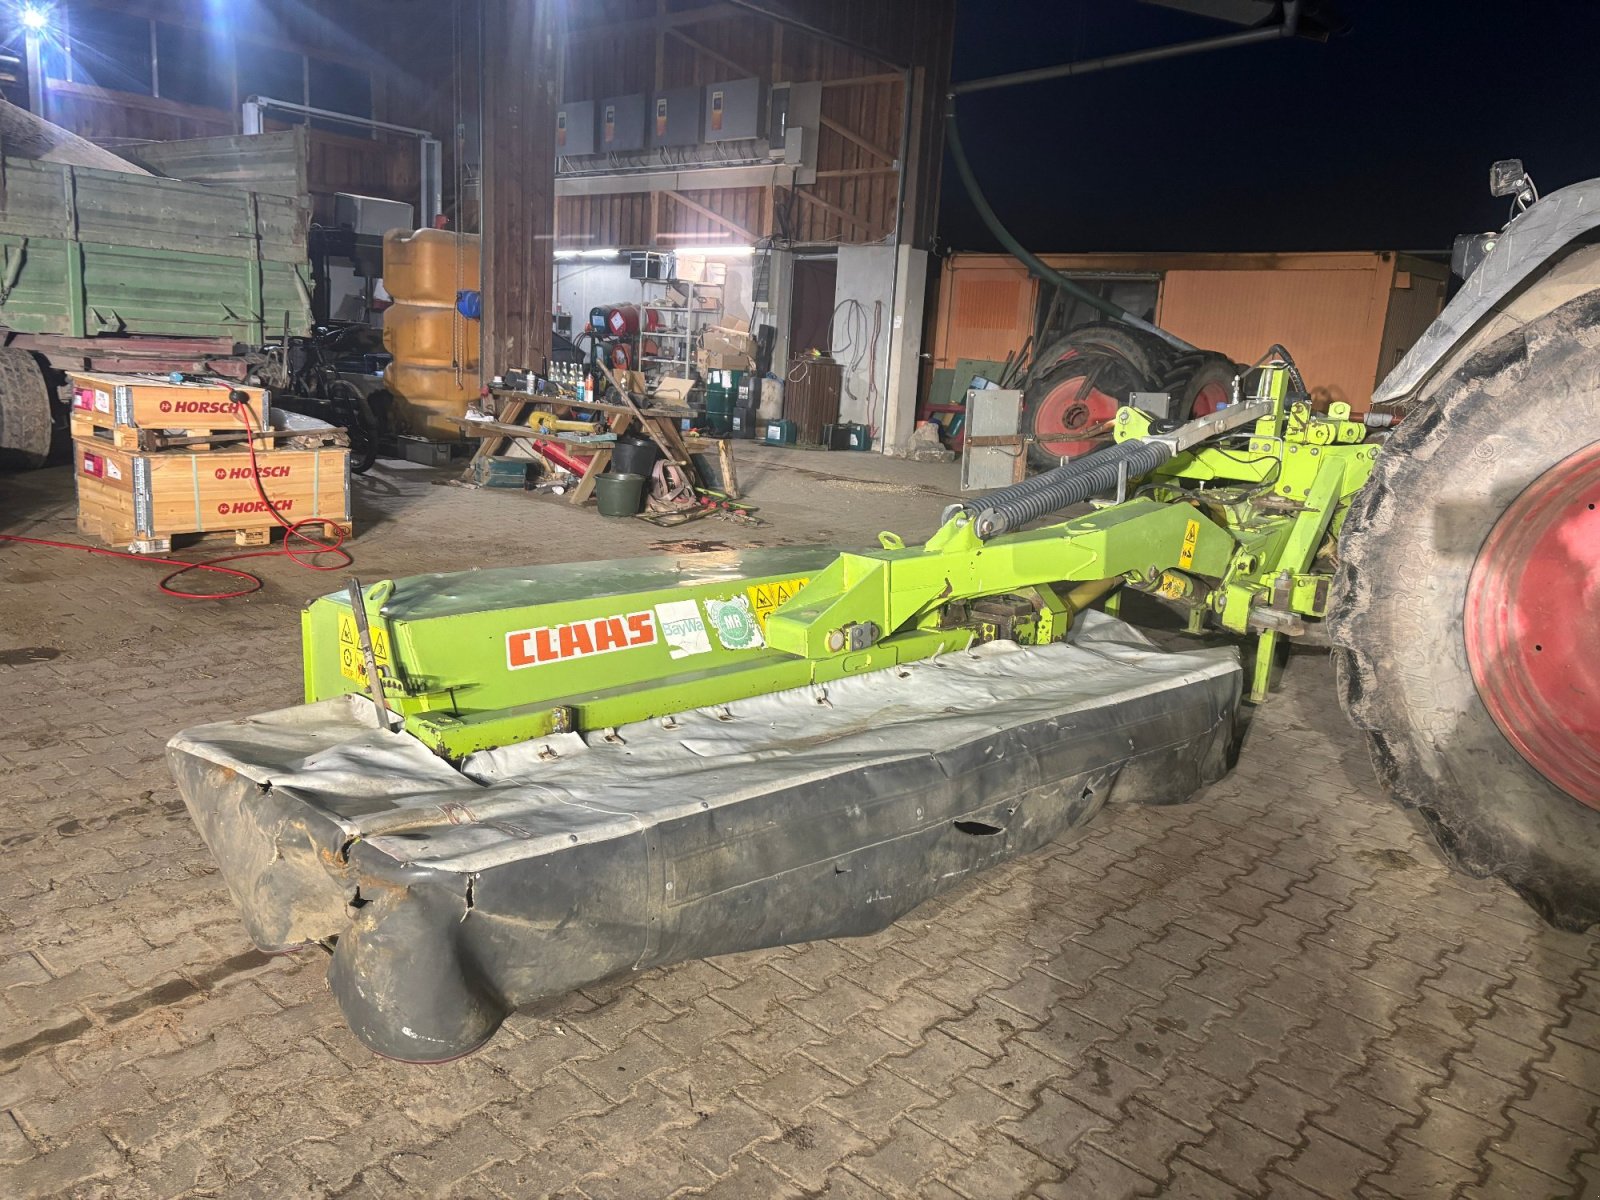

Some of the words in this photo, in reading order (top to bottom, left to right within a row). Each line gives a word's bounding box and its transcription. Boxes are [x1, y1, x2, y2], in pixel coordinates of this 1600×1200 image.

[175, 401, 239, 414] HORSCH
[662, 618, 704, 636] BayWa
[723, 614, 742, 630] MR
[508, 613, 654, 667] CLAAS
